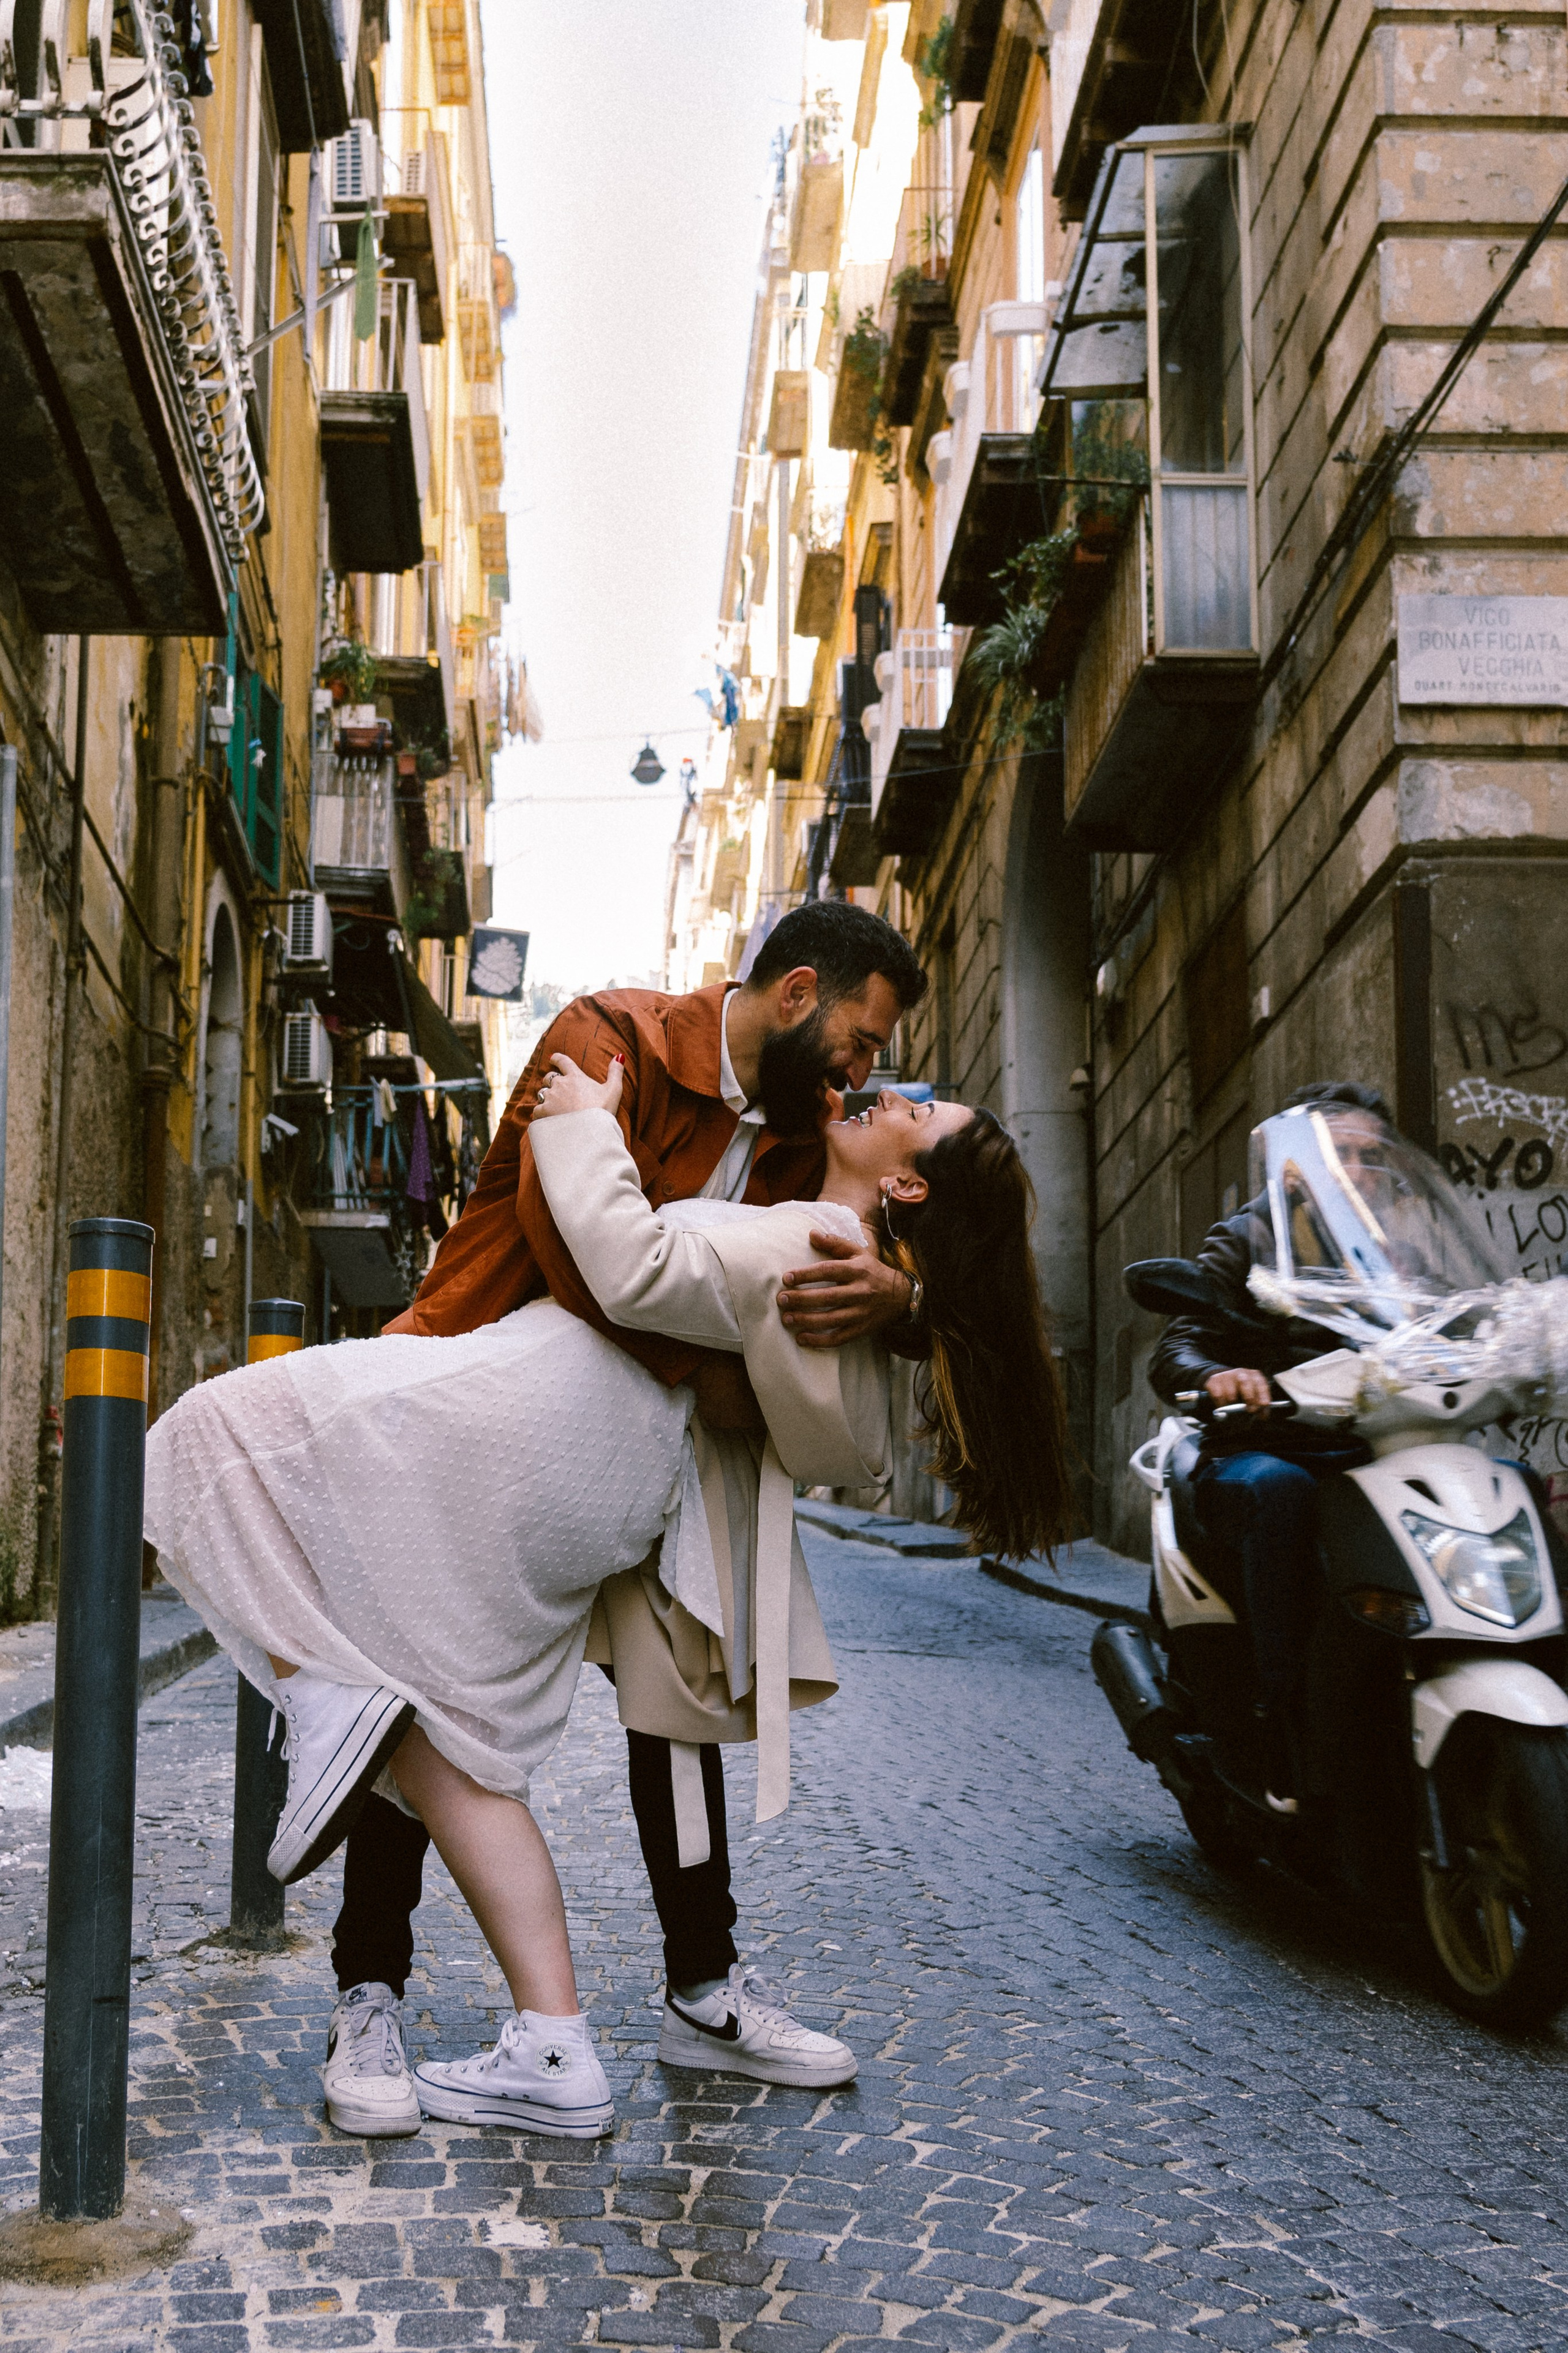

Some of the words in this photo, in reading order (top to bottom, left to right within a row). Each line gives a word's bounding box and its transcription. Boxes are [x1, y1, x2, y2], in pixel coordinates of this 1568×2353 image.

[1464, 605, 1510, 627] VICO
[1419, 631, 1561, 652] BONAFFICIATA
[1458, 656, 1544, 677] VECCHIA
[539, 2044, 568, 2056] CONVERSE
[553, 2068, 567, 2076] STAR
